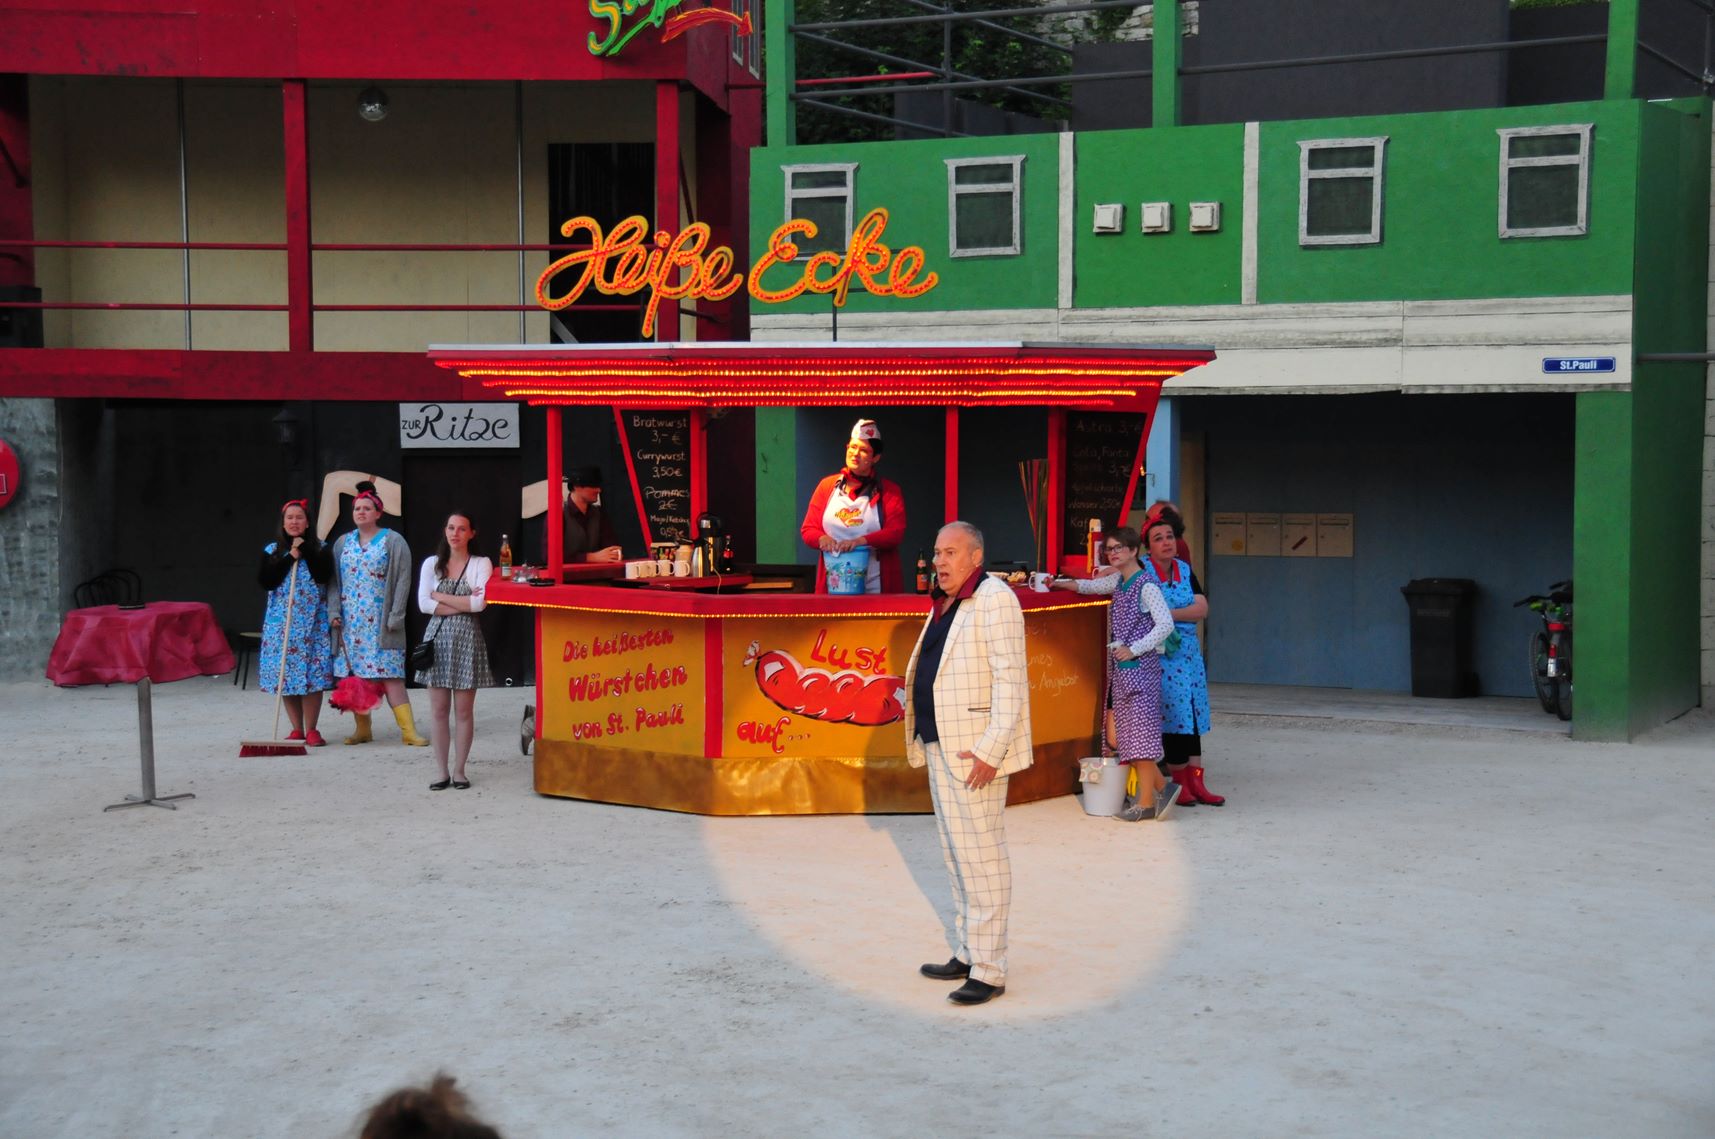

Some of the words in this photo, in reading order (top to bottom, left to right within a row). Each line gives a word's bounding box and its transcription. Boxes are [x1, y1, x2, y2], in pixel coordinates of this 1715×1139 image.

[536, 215, 744, 338] Heiße
[748, 207, 938, 307] Ecke
[401, 420, 421, 430] ZUR
[406, 404, 511, 441] Ritze
[633, 415, 687, 428] Bratwurst
[637, 449, 685, 464] Currywurst
[644, 486, 689, 499] Pommes
[563, 640, 588, 662] Die
[592, 628, 674, 656] heißesten
[810, 629, 887, 675] Lust
[569, 662, 688, 702] Würstchen
[572, 721, 603, 740] von
[606, 712, 630, 735] St.
[635, 703, 685, 732] Pauli
